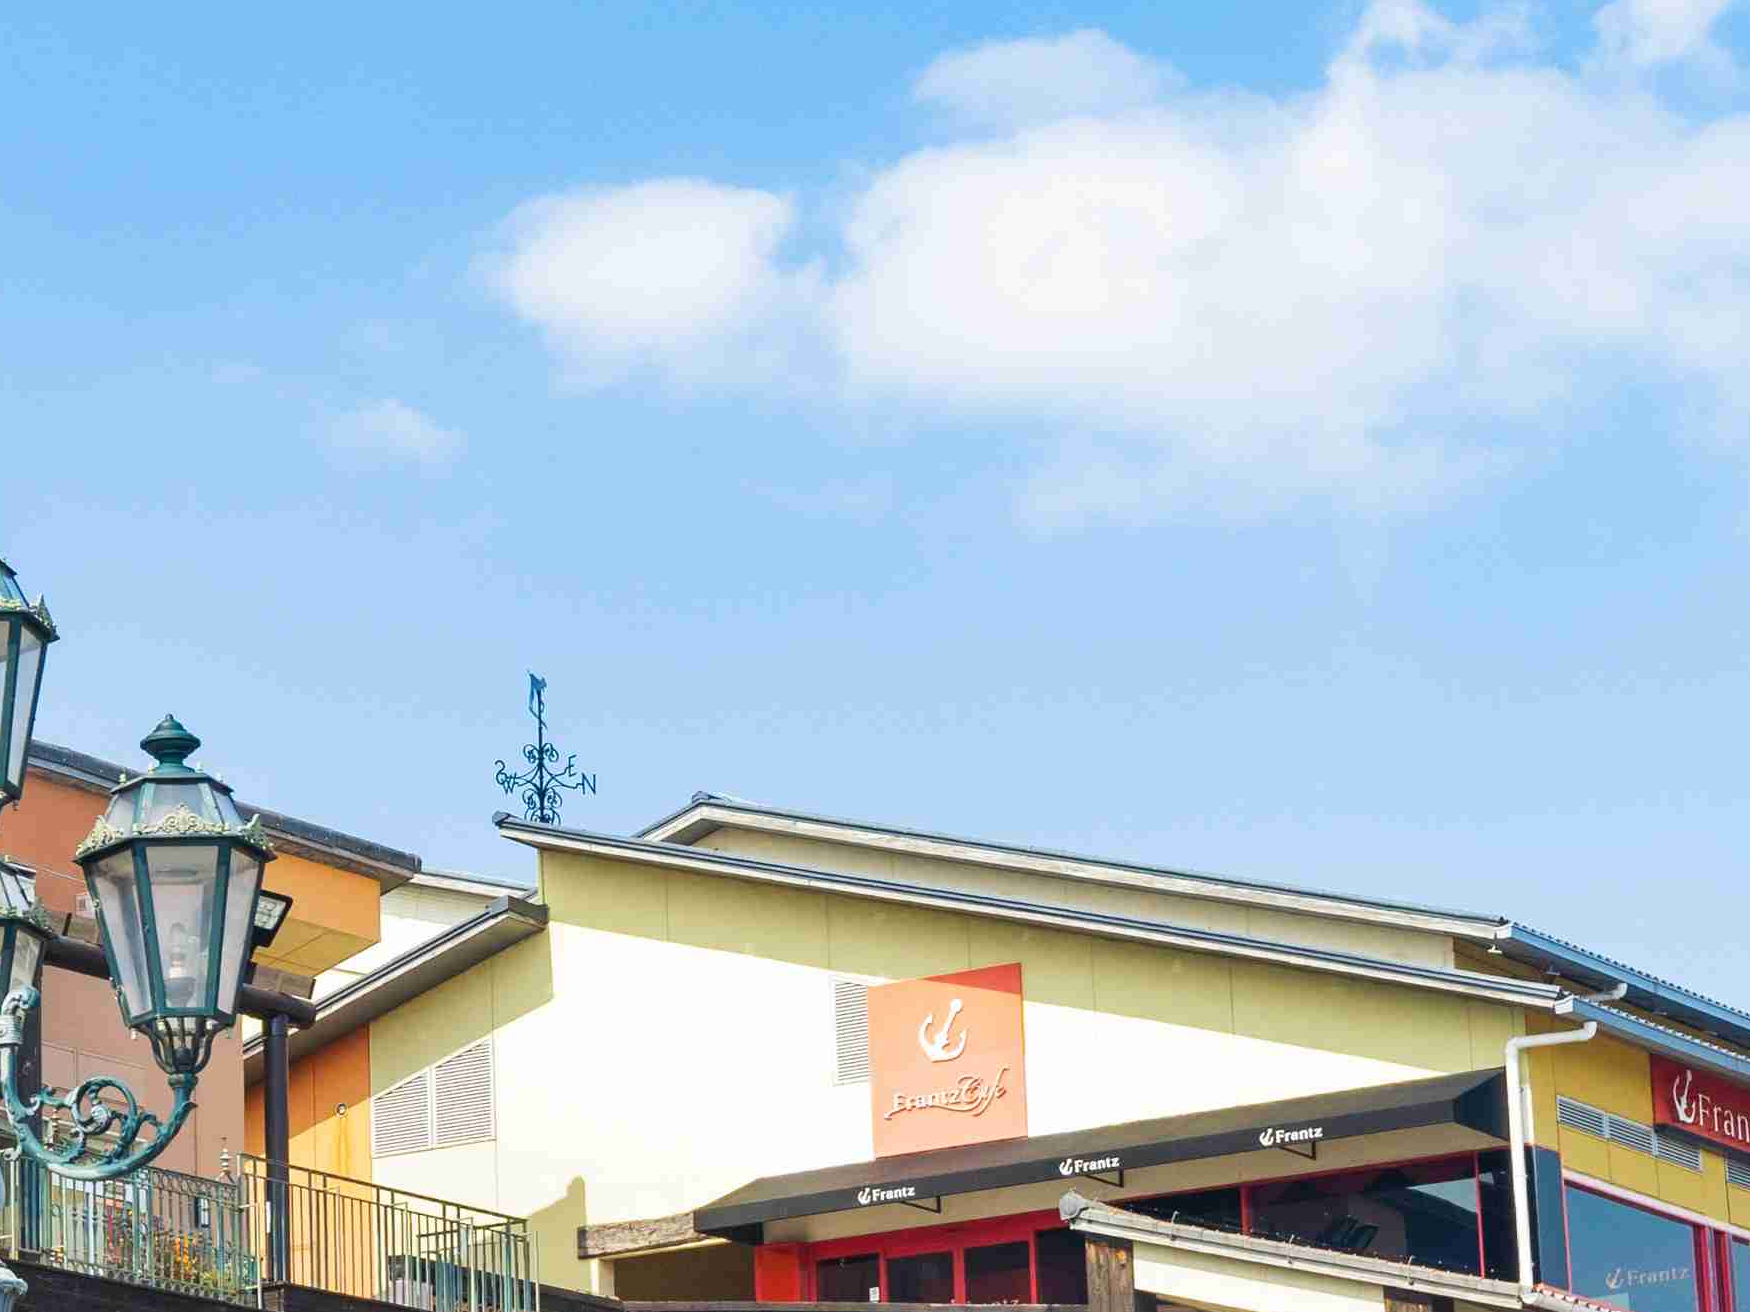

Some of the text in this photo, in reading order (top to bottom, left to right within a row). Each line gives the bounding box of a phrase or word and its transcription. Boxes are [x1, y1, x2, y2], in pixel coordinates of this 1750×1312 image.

[581, 772, 597, 795] N
[1275, 1127, 1323, 1144] Frantz
[1074, 1156, 1120, 1173] Frantz
[872, 1187, 916, 1202] Frantz
[1627, 1267, 1691, 1287] Frantz
